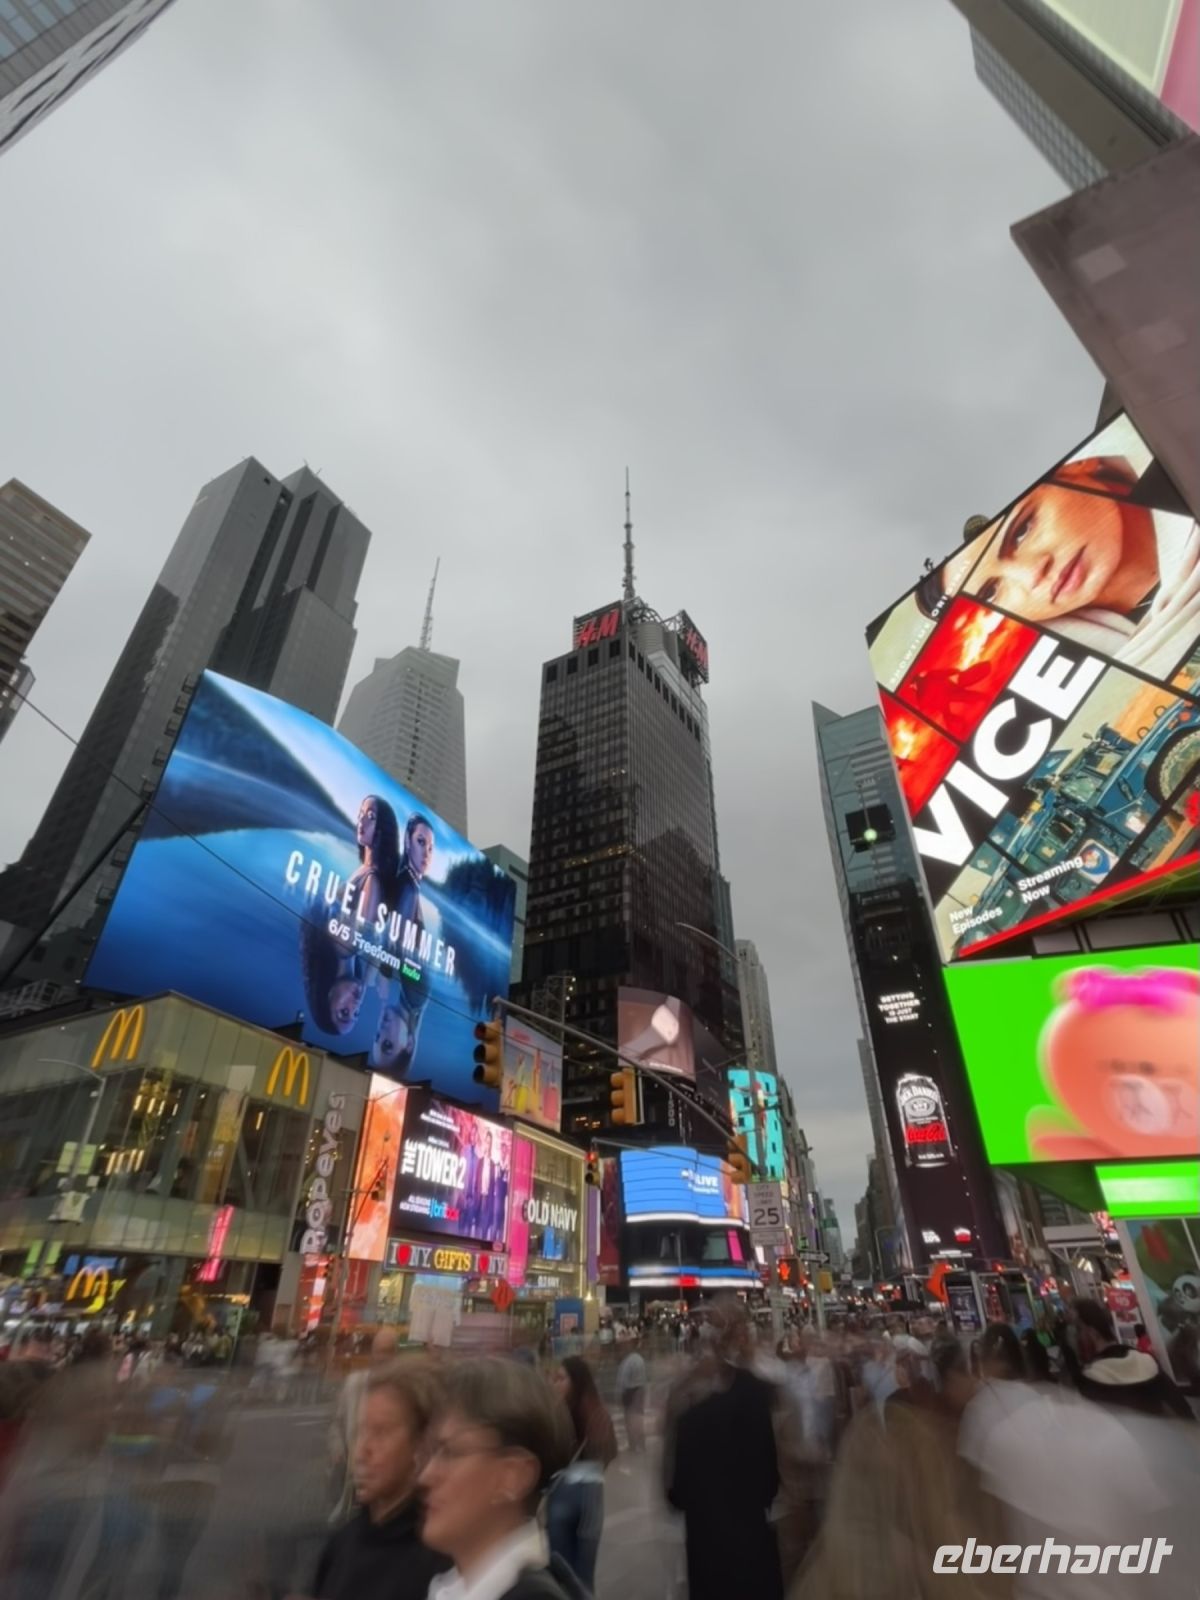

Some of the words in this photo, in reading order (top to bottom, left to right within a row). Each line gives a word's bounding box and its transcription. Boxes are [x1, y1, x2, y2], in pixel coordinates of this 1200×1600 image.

[912, 634, 1107, 866] VICE
[1017, 856, 1084, 891] Streaming
[1021, 884, 1050, 904] Now
[285, 850, 366, 923] CRUEL
[375, 902, 456, 976] SUMMER
[949, 905, 974, 923] New
[951, 906, 1003, 935] Episodes
[328, 918, 351, 941] 6/5
[352, 931, 401, 970] Freeform
[402, 963, 421, 981] hulu
[401, 1138, 418, 1174] THE
[416, 1143, 459, 1188] TOWER
[695, 1174, 719, 1188] LIVE
[527, 1198, 549, 1226] OLD
[550, 1203, 578, 1232] NAVY
[753, 1207, 780, 1226] 25
[434, 1248, 472, 1272] GIFTS
